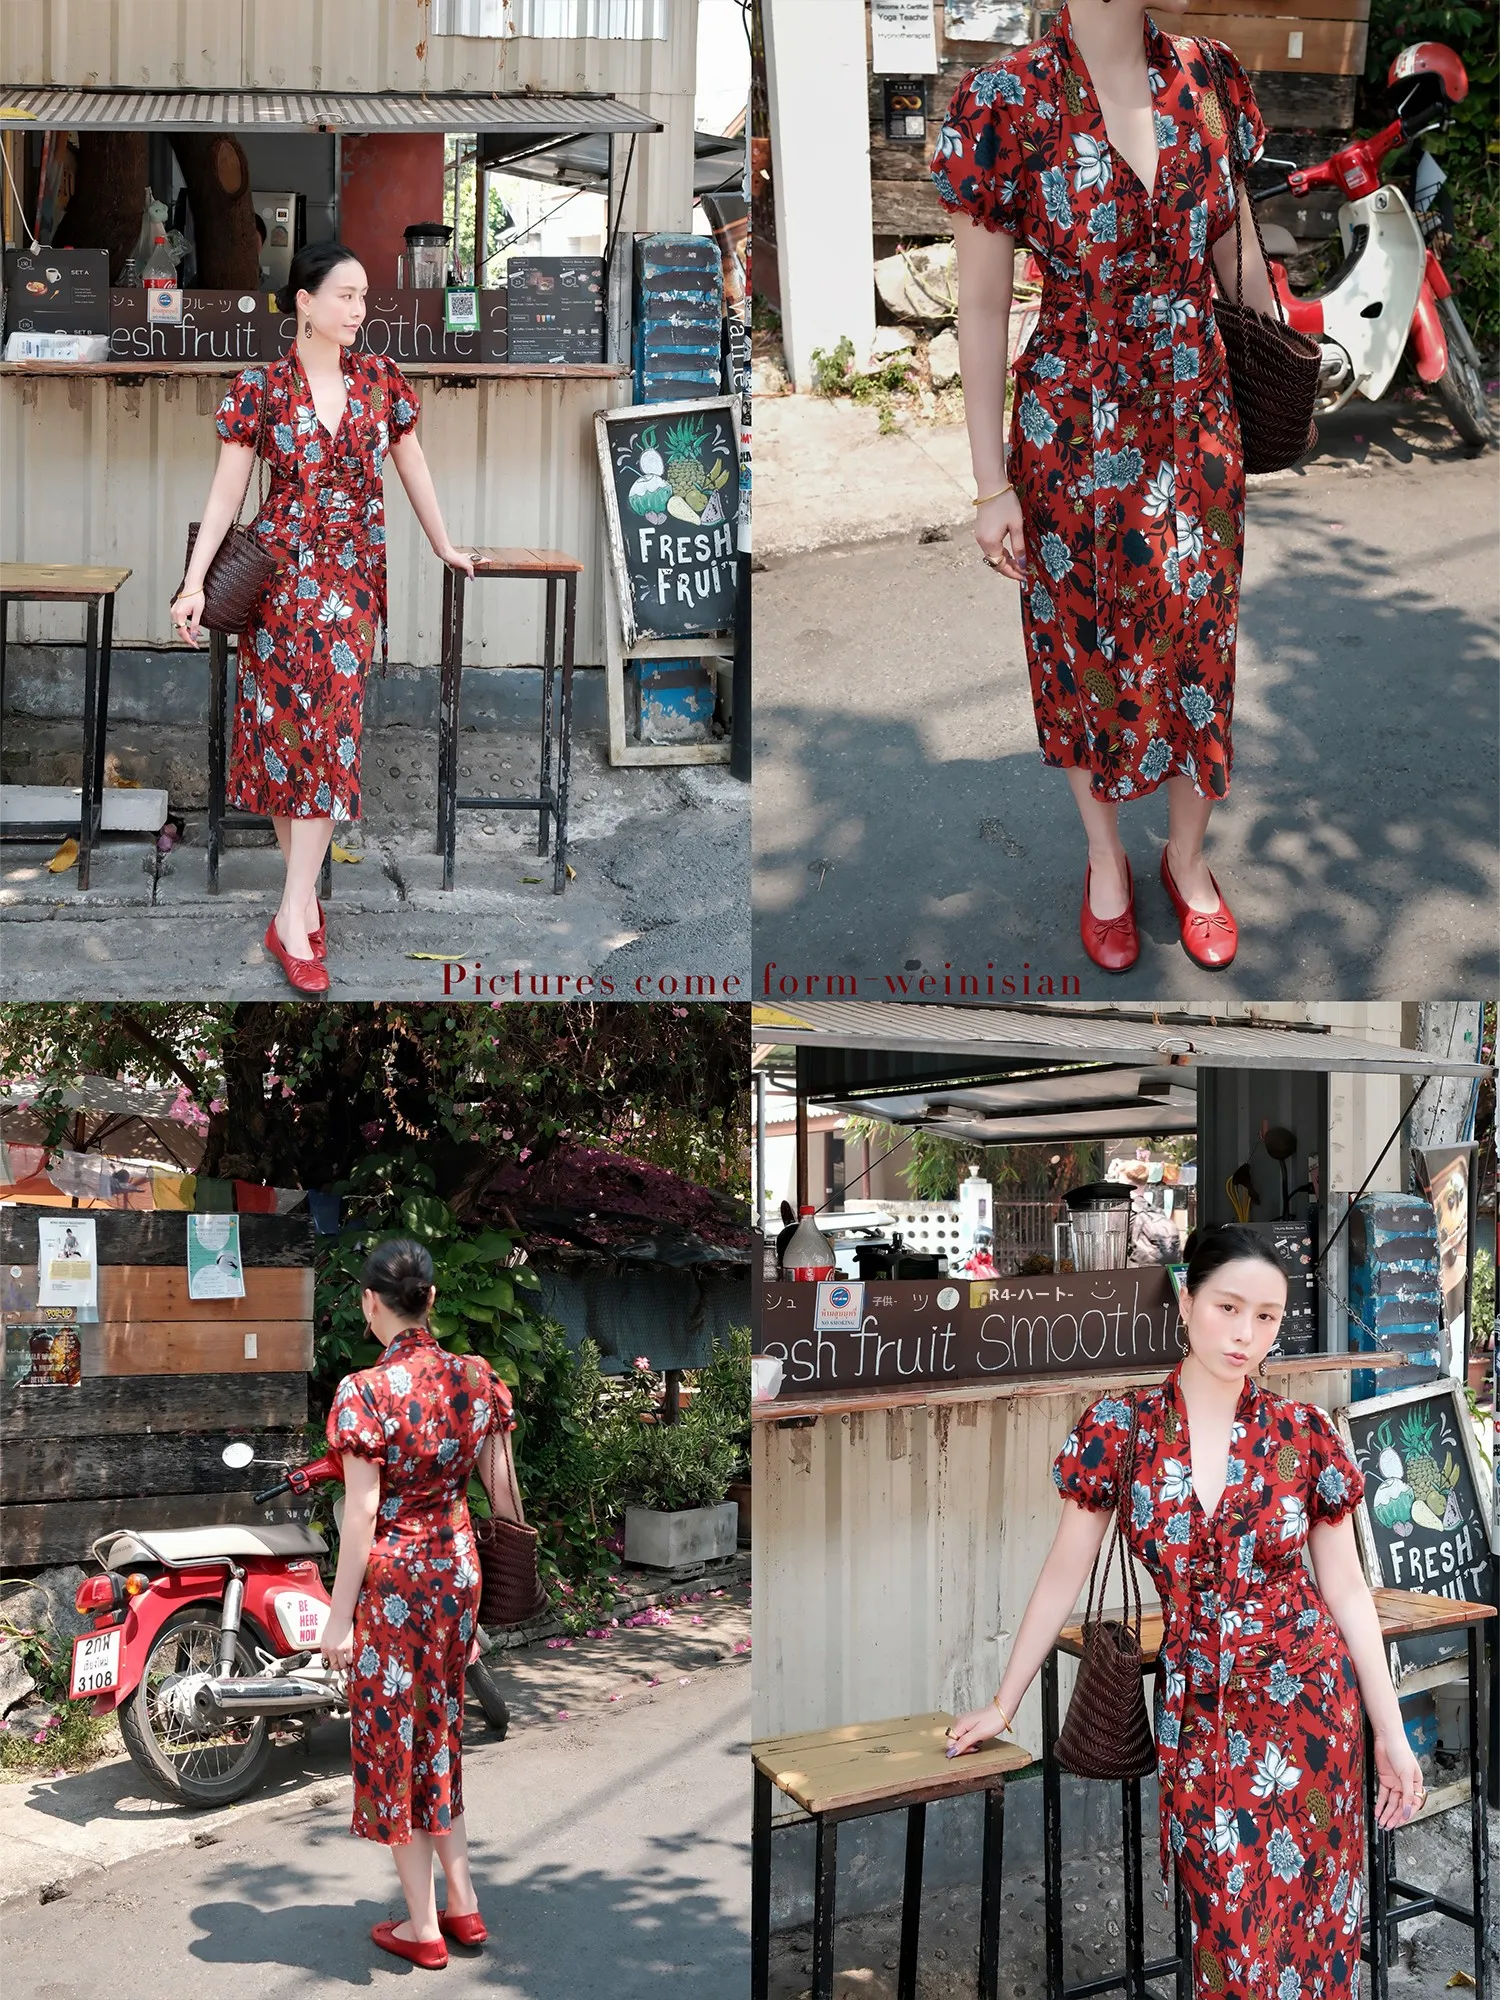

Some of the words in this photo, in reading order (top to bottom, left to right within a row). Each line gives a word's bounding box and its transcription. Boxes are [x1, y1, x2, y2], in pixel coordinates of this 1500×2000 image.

[877, 13, 897, 22] Yoga
[899, 13, 929, 21] Teacher
[877, 32, 931, 40] Hypnotherapist
[110, 322, 167, 357] esh
[174, 313, 258, 358] fruit
[638, 522, 733, 567] FRESH
[45, 1307, 73, 1320] POP-UP
[850, 1315, 957, 1377] fruit
[1389, 1524, 1473, 1584] FRESH
[298, 1600, 309, 1612] BE
[299, 1613, 319, 1627] HERE
[299, 1628, 317, 1642] NOW
[78, 1670, 113, 1693] 3108
